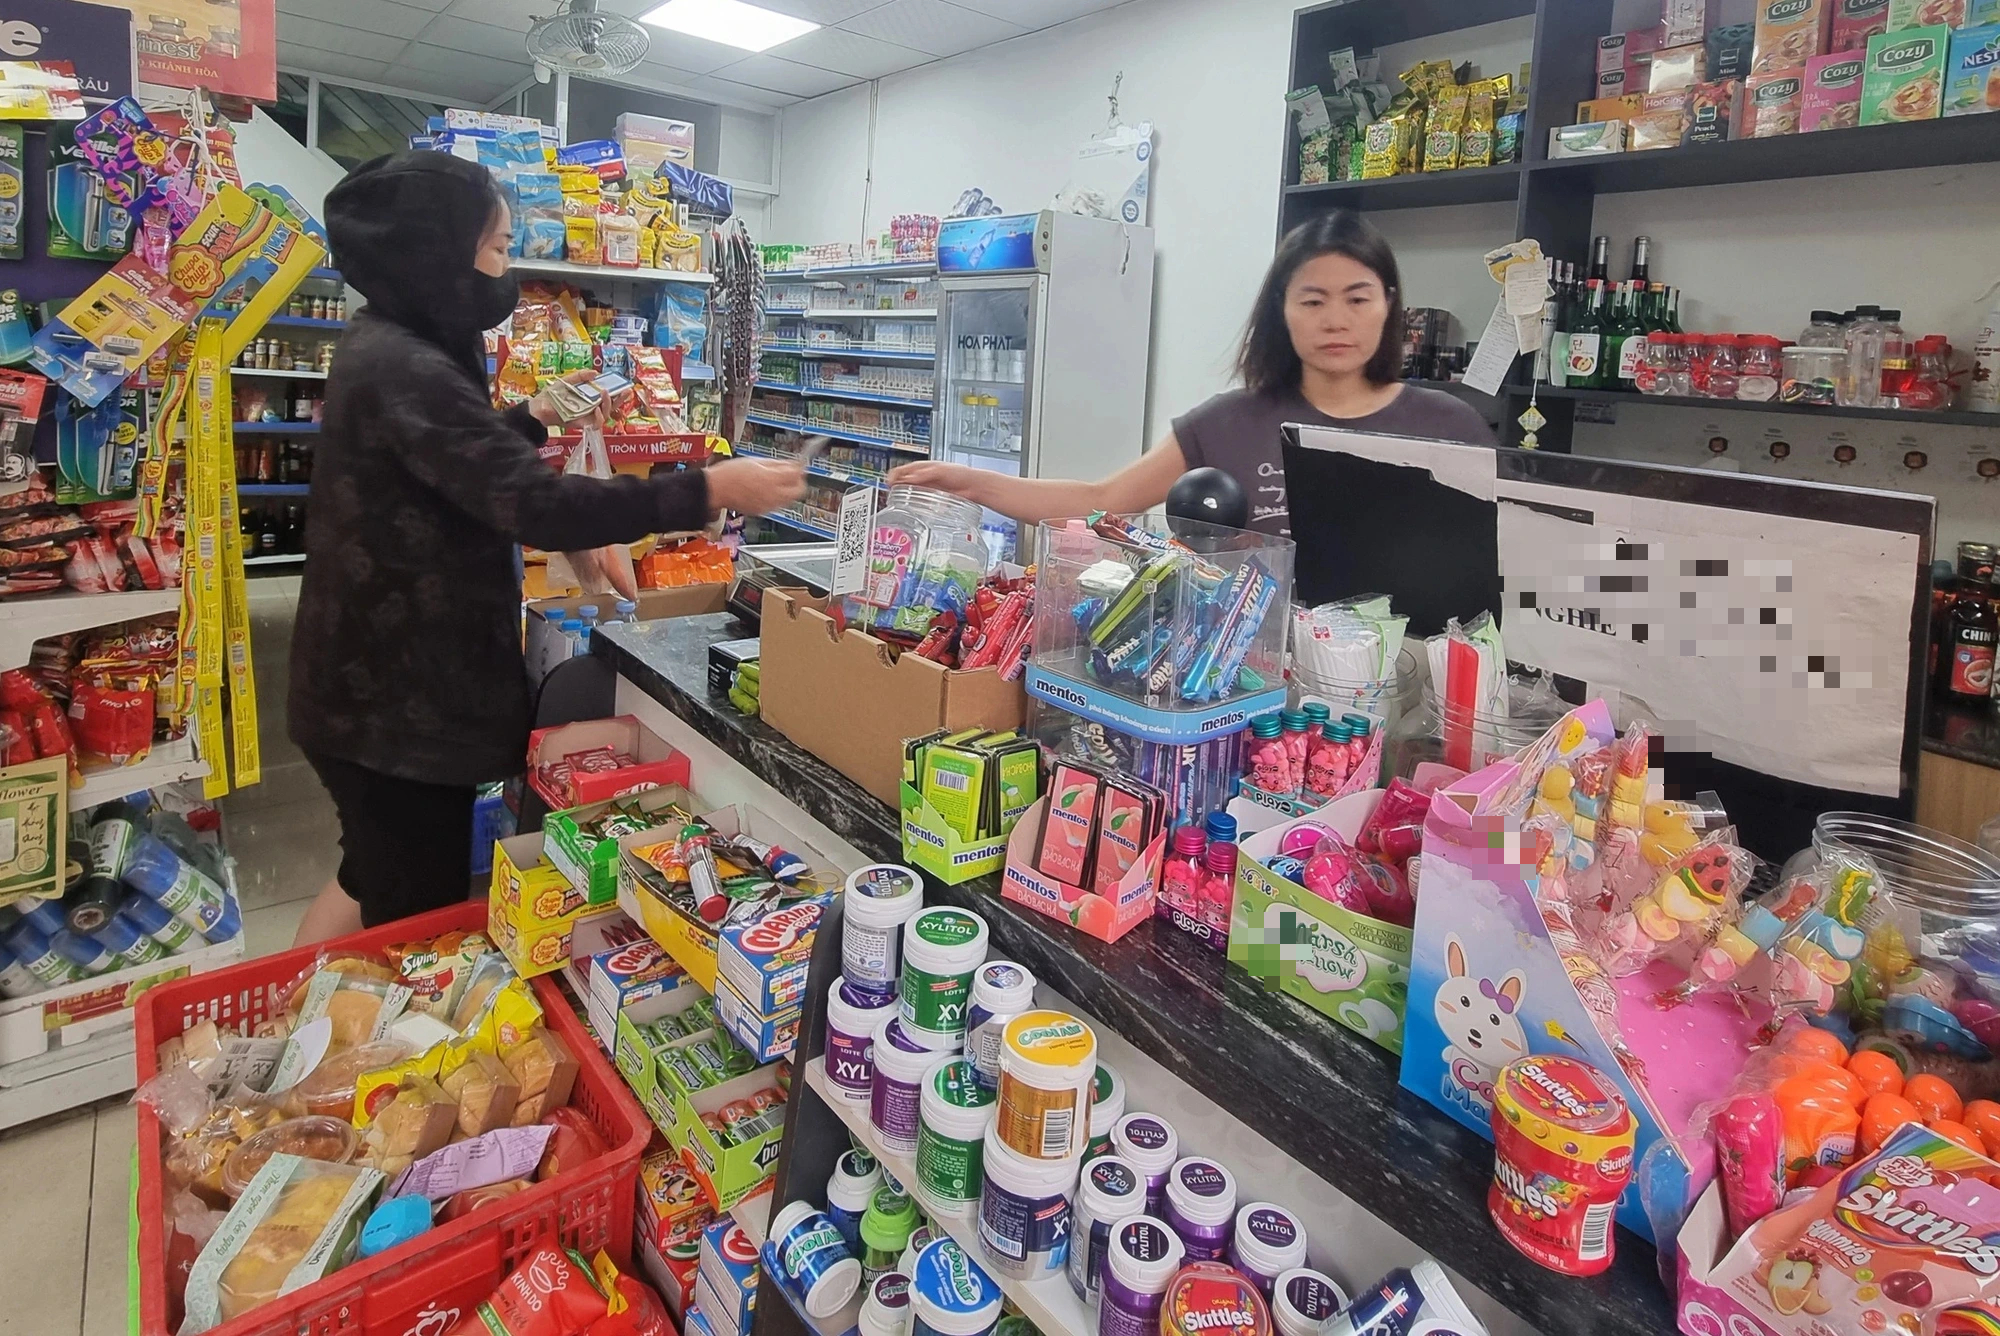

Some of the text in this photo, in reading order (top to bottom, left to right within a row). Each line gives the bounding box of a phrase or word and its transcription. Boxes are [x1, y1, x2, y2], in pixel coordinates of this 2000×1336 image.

[1772, 0, 1807, 15] Cozy
[1883, 45, 1926, 63] Cozy
[1823, 64, 1859, 79] Cozy
[1759, 81, 1796, 97] Cozy
[173, 253, 200, 281] Chupa
[182, 262, 210, 290] Chups
[1036, 679, 1086, 707] mentos
[1201, 711, 1244, 732] mentos
[1052, 808, 1088, 826] mentos
[906, 822, 944, 847] mentos
[1103, 829, 1136, 850] mentos
[953, 844, 1006, 864] mentos
[1007, 867, 1058, 900] mentos
[1121, 879, 1153, 905] mentos
[920, 920, 973, 936] XYLITOL
[402, 951, 438, 976] Swing
[944, 988, 966, 997] LOTTE
[841, 1048, 861, 1057] LOTTE
[1521, 1064, 1587, 1116] Skittles
[1129, 1127, 1164, 1139] XYLITOL
[1600, 1153, 1632, 1172] Skittles
[1892, 1158, 1928, 1179] FRUIT
[1097, 1166, 1129, 1189] XYLITOL
[1184, 1174, 1222, 1185] XYLITOL
[1881, 1165, 1919, 1184] JUICE
[1495, 1160, 1558, 1217] kittles
[1251, 1219, 1293, 1236] XYLITOL
[1837, 1184, 2000, 1275] Skittles
[1140, 1225, 1149, 1259] XYLITOL
[1306, 1280, 1318, 1315] XYLITOL
[1185, 1308, 1254, 1331] Skittles
